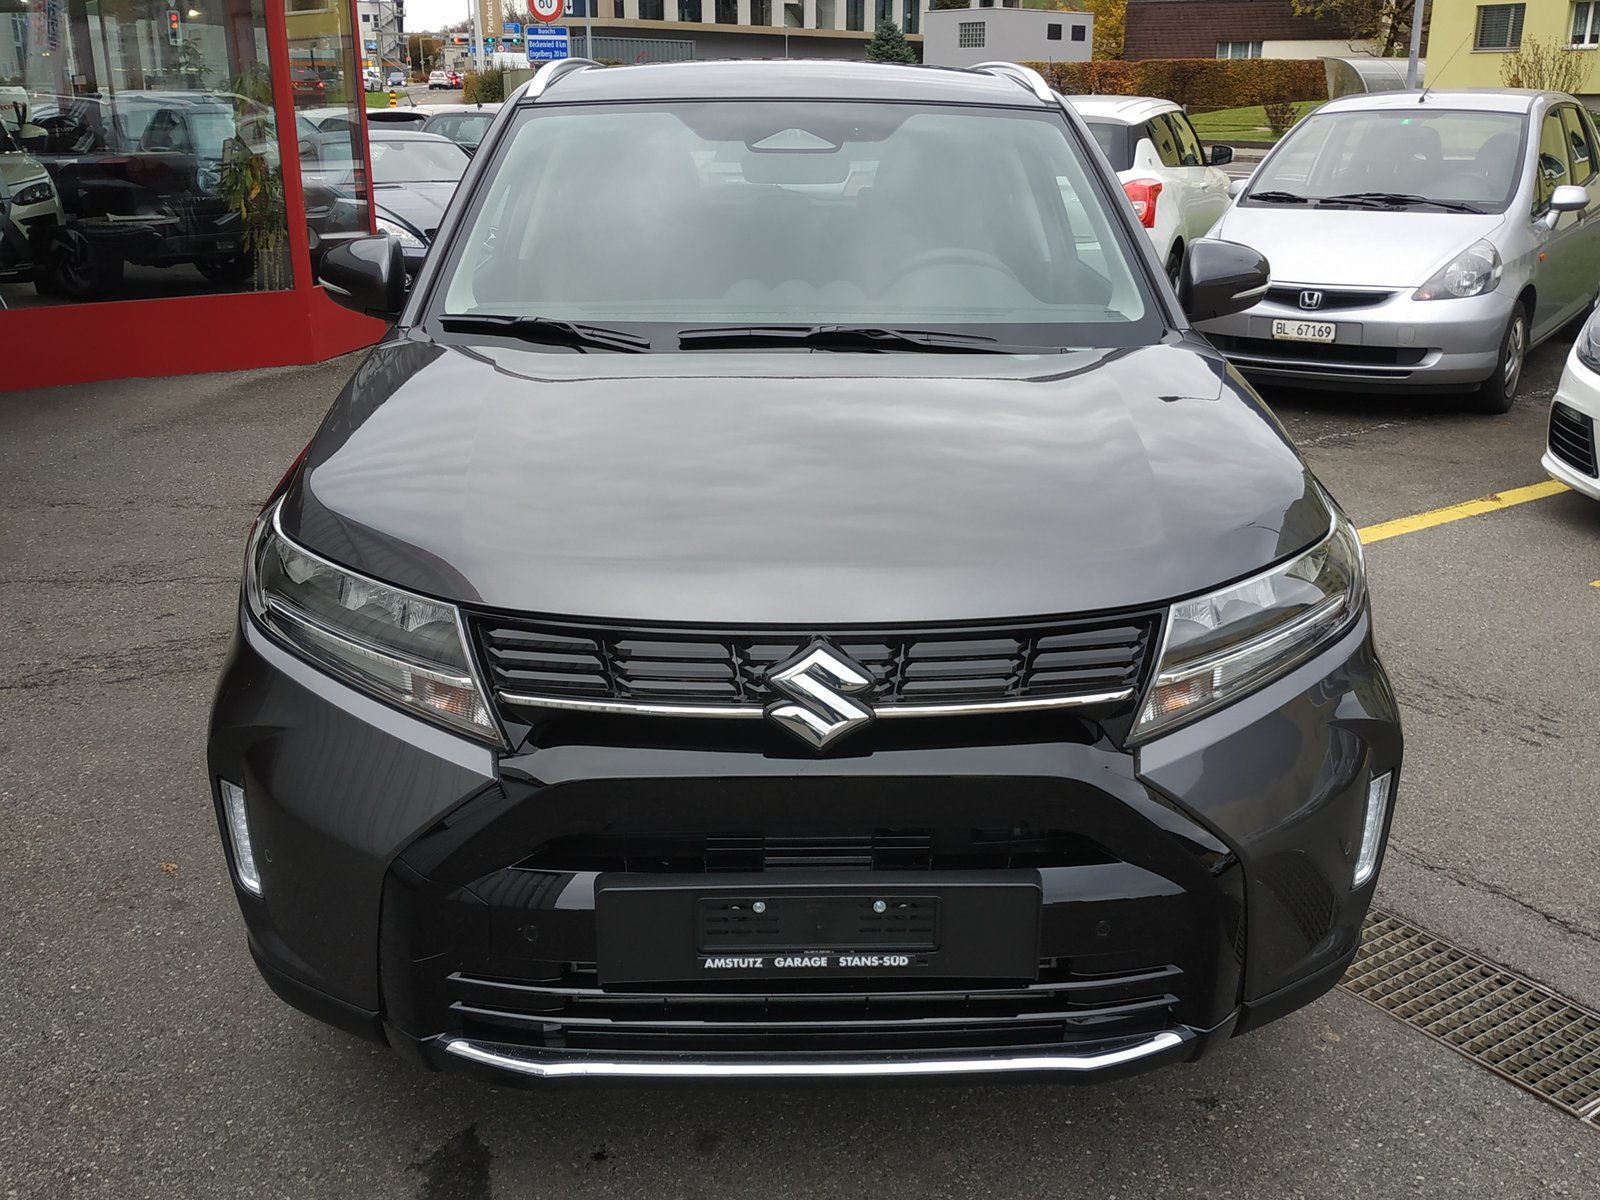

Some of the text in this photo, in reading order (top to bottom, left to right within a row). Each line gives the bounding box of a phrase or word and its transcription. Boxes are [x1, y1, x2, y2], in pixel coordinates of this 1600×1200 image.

[538, 0, 553, 9] 60
[529, 50, 552, 59] Engelberg
[1276, 322, 1332, 338] BL 67169
[704, 955, 909, 968] AMSTUTZ GARAGE STANS-SÜD
